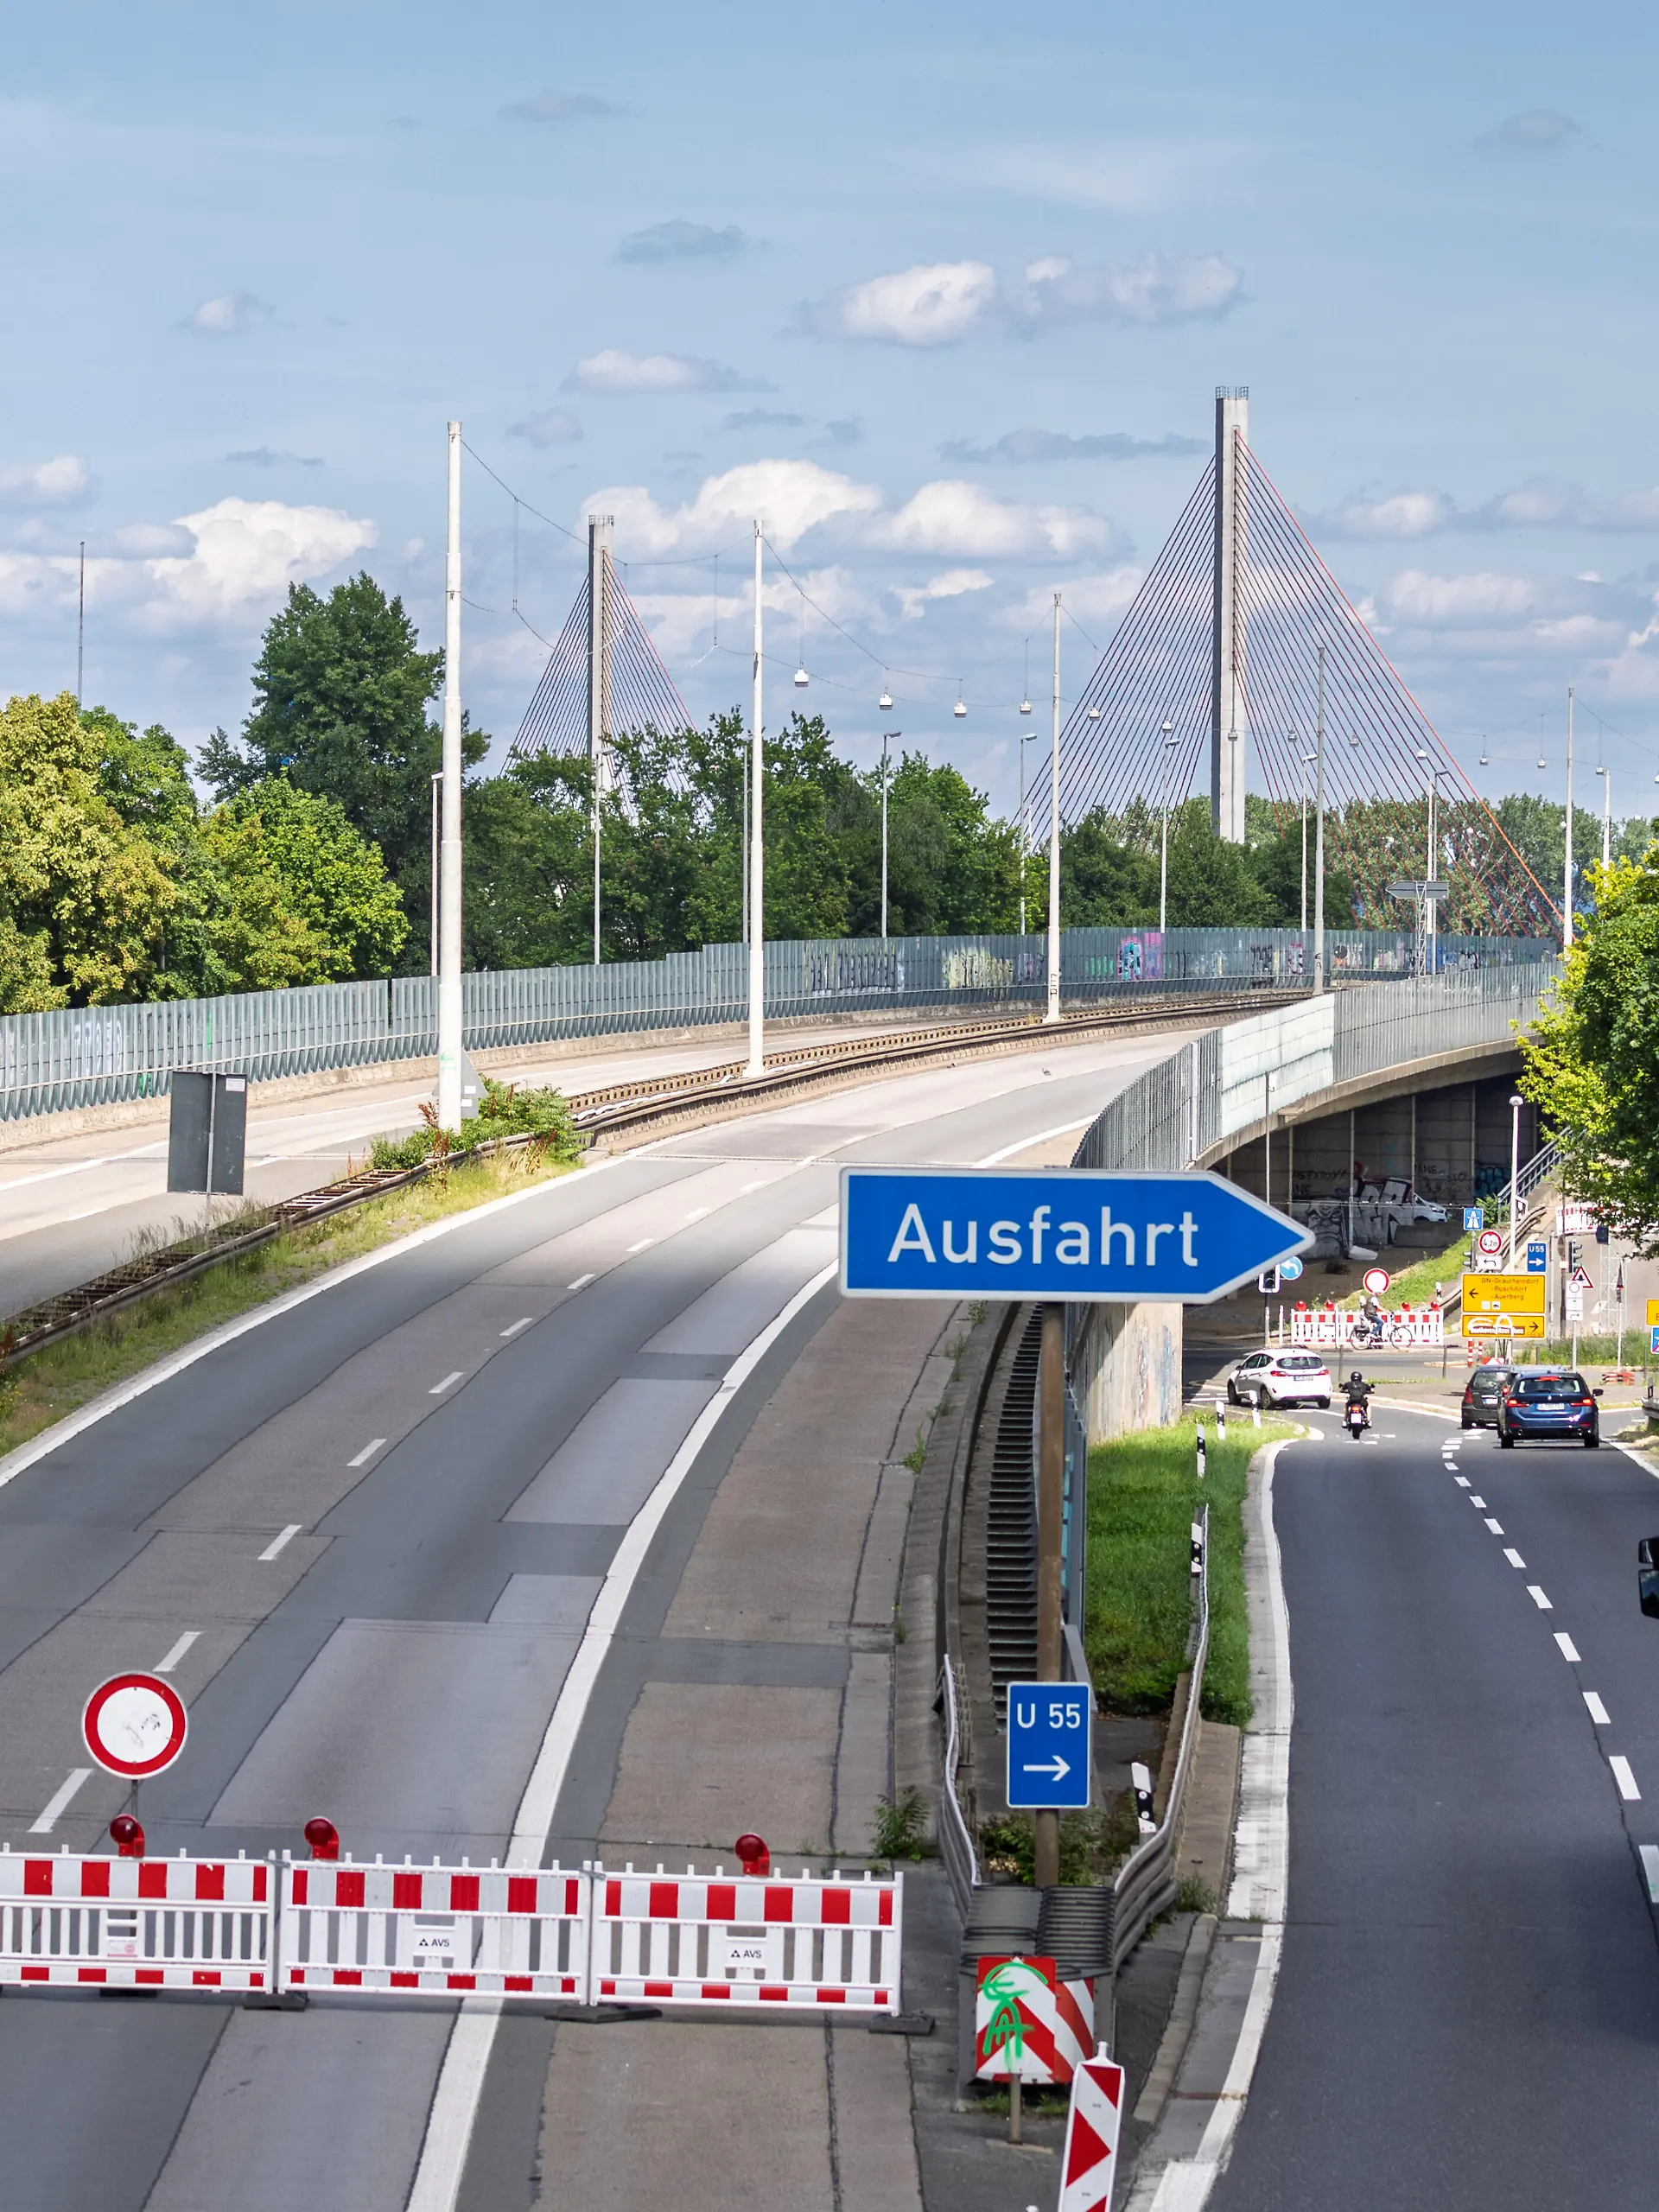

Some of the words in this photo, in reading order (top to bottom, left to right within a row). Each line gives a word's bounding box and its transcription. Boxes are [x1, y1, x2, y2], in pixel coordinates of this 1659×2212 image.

[887, 1203, 1199, 1268] Ausfahrt
[1016, 1702, 1036, 1729] U
[1049, 1703, 1081, 1729] 55
[430, 1937, 450, 1948] AVS
[742, 1949, 762, 1960] AVS
